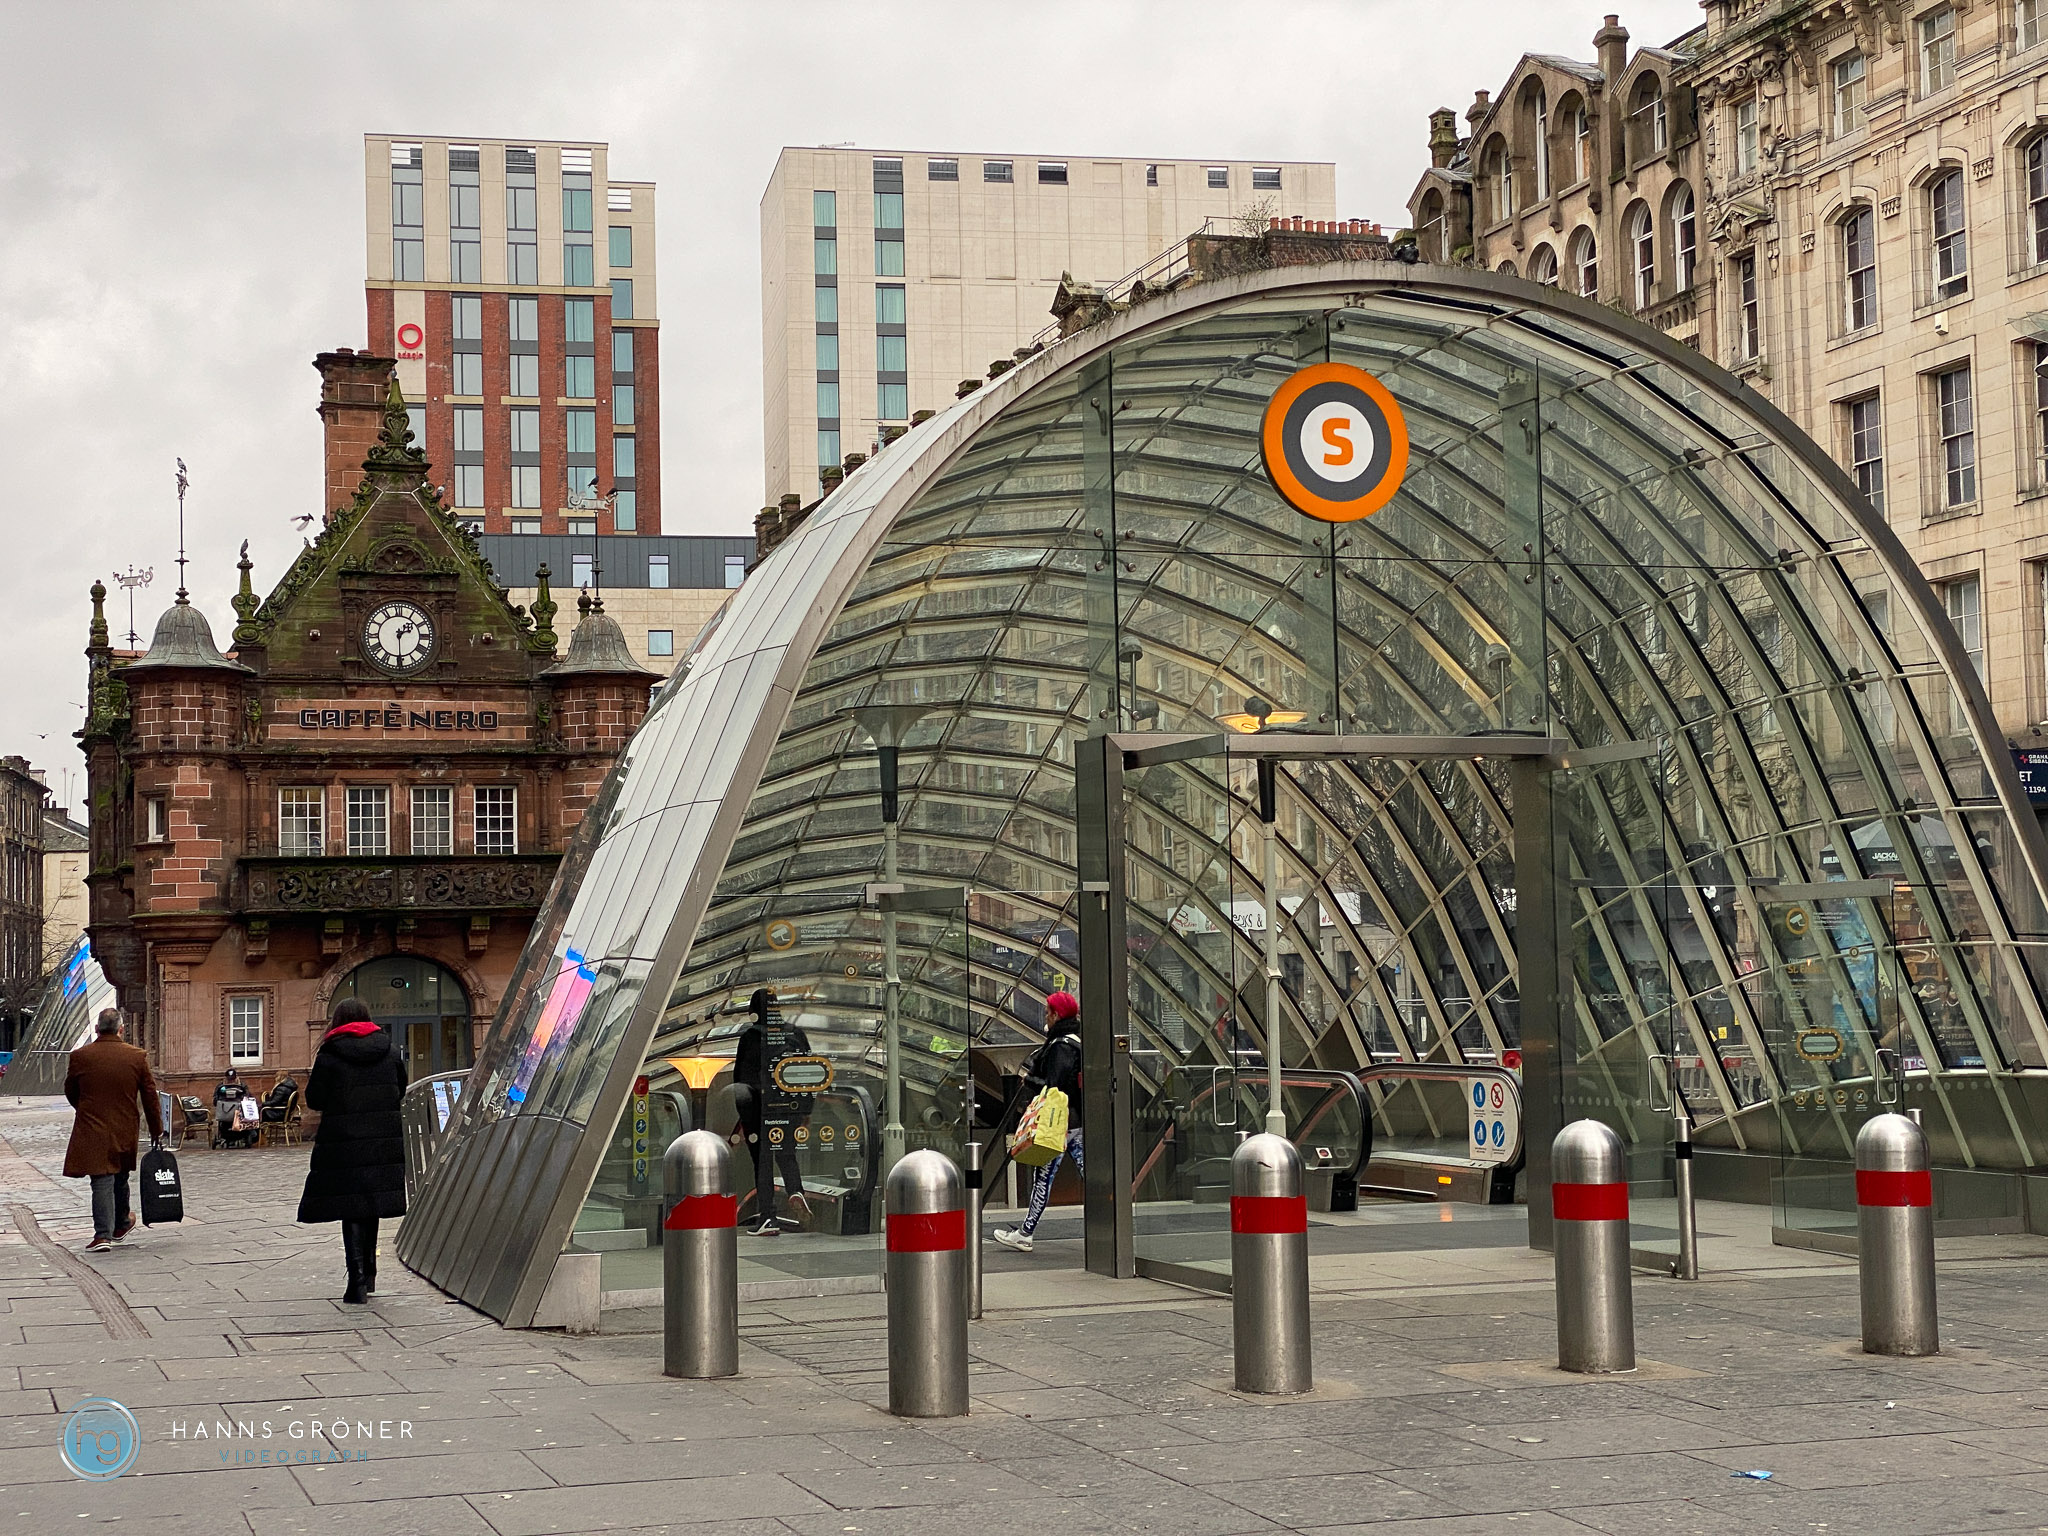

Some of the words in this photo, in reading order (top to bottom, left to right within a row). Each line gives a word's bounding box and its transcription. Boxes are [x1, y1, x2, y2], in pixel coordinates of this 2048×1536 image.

[1322, 417, 1354, 466] S
[299, 702, 402, 729] CAFFÈ
[409, 709, 498, 731] NERO
